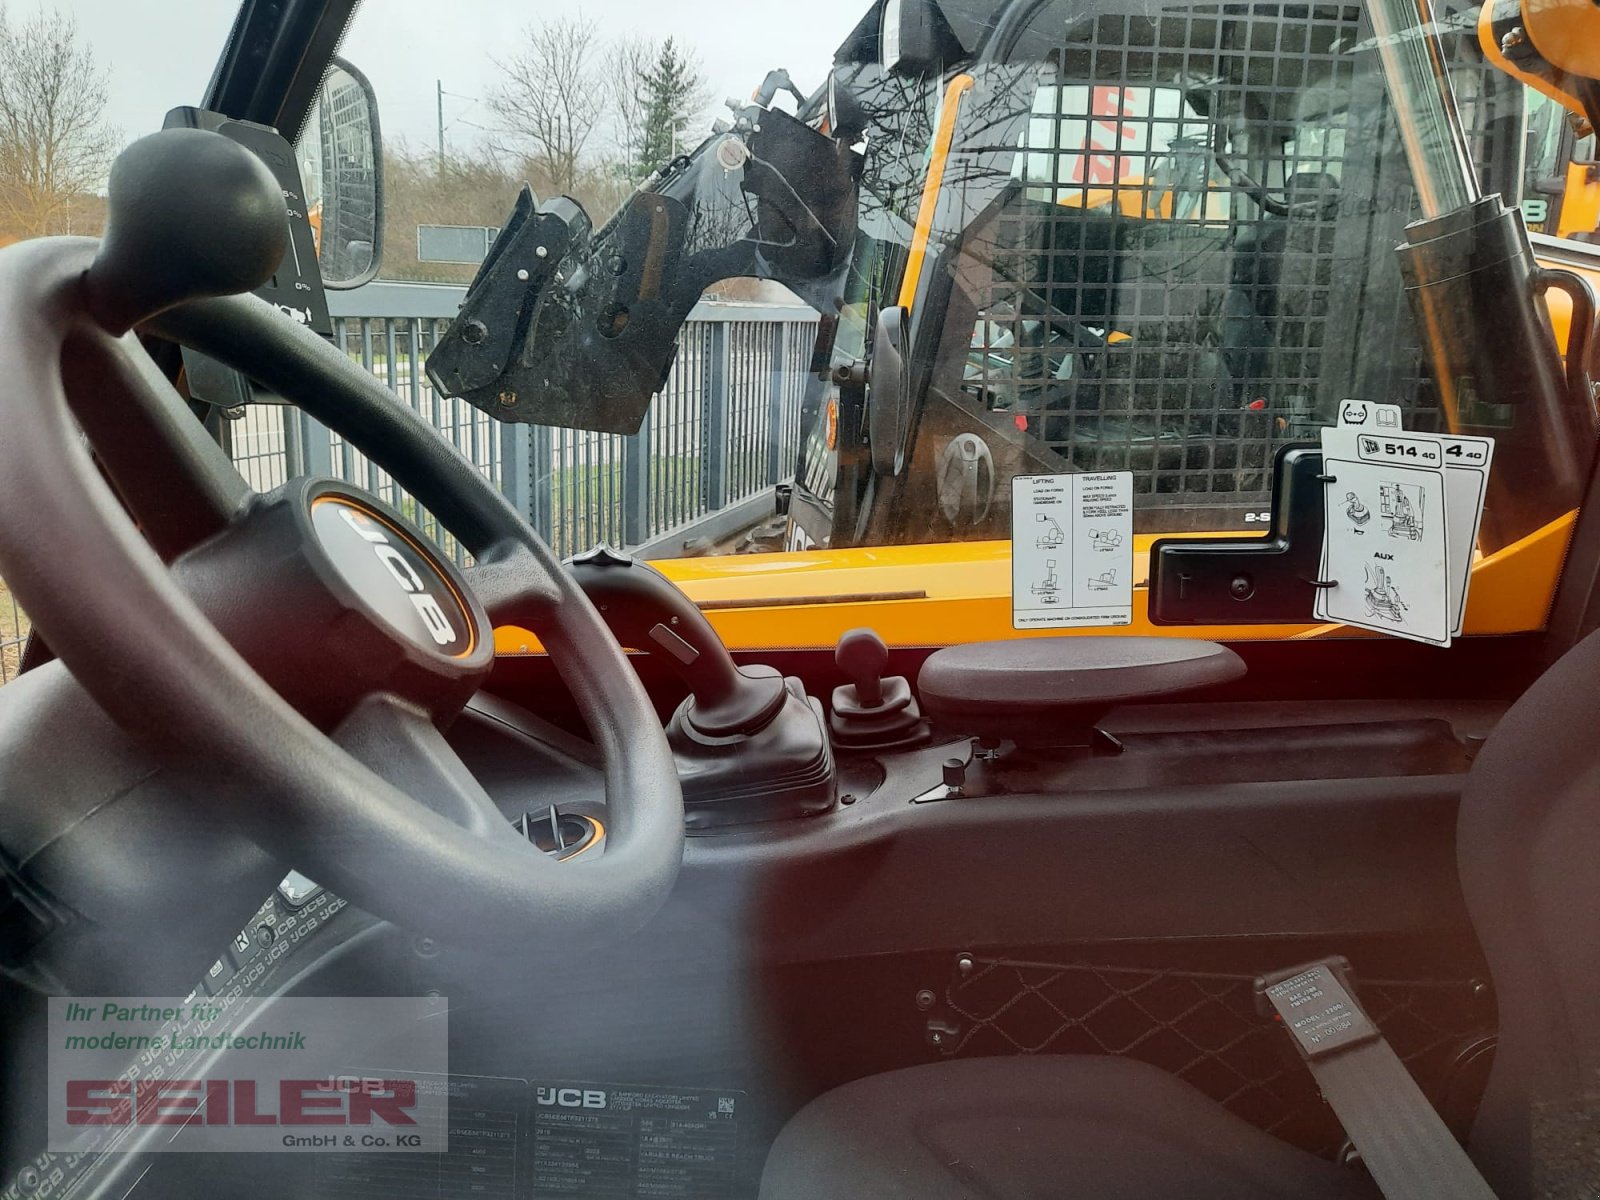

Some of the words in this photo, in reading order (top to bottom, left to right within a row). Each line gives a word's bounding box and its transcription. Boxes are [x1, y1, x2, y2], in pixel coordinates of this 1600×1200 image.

[295, 282, 312, 291] 0%
[1385, 443, 1418, 458] 514
[1421, 452, 1436, 460] 40
[1466, 452, 1482, 460] 40
[1373, 551, 1395, 561] AUX
[338, 509, 457, 645] JCB
[299, 894, 327, 919] JCB
[219, 985, 243, 1012] JCB
[243, 962, 265, 988] JCB
[264, 940, 290, 966] JCB
[290, 917, 318, 943] JCB
[1294, 1014, 1320, 1028] MODEL
[317, 1075, 385, 1095] JCB
[536, 1087, 607, 1109] JCB
